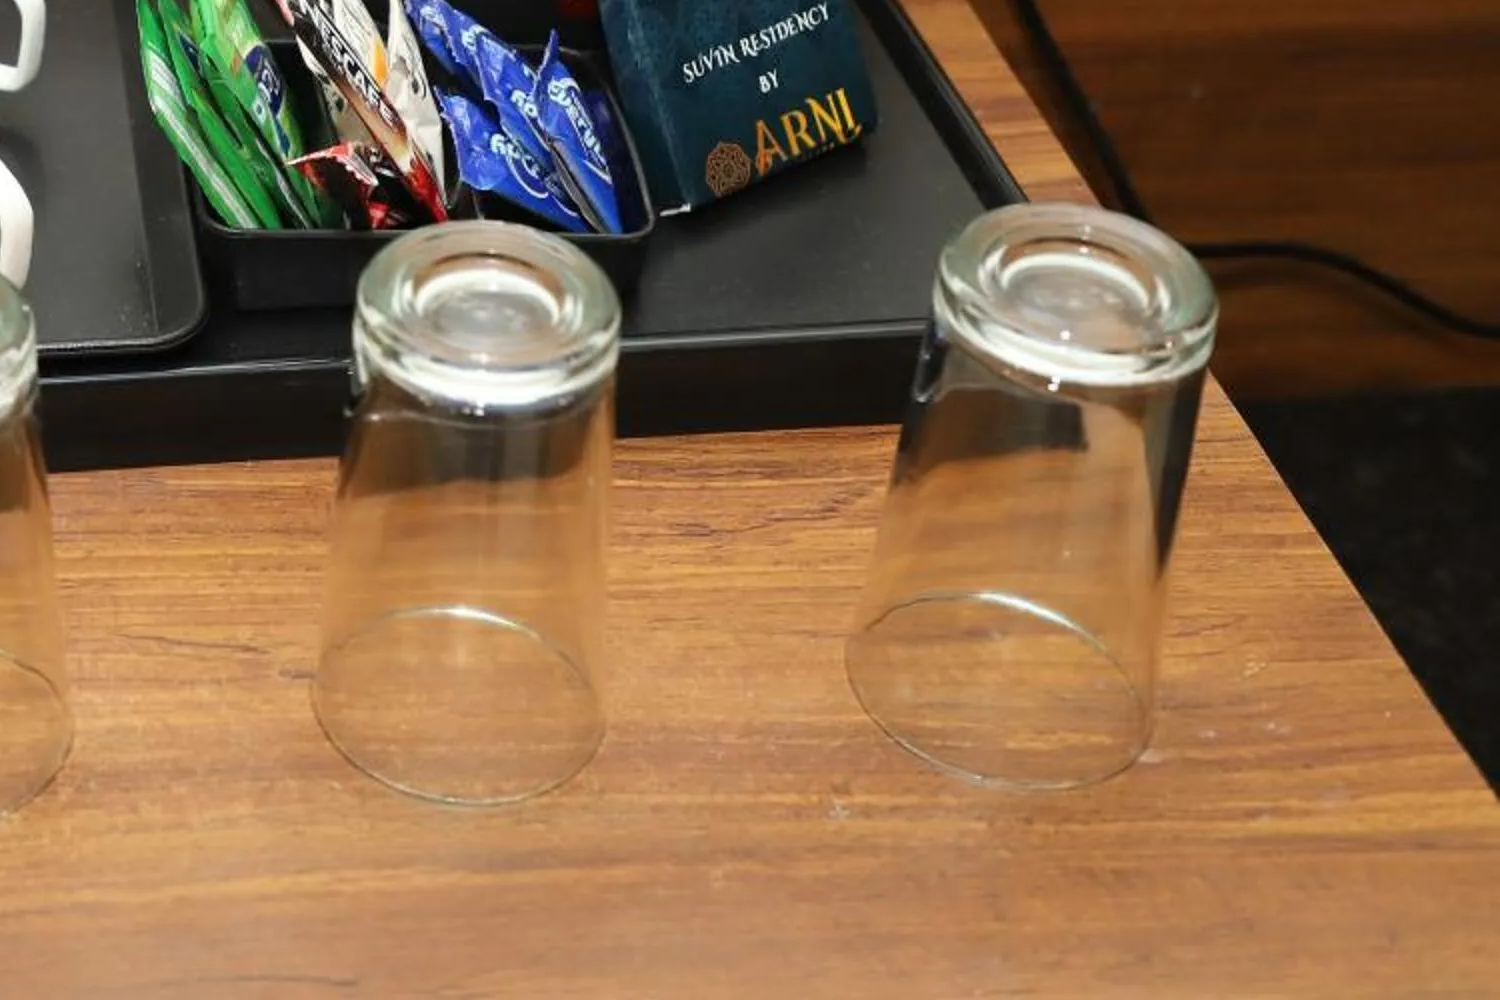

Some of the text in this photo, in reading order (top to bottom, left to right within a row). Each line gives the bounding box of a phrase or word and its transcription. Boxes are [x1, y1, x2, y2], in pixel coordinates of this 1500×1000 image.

[683, 1, 829, 83] SUVIN RESIDENCY
[758, 68, 780, 93] BY
[755, 87, 863, 177] ARNI
